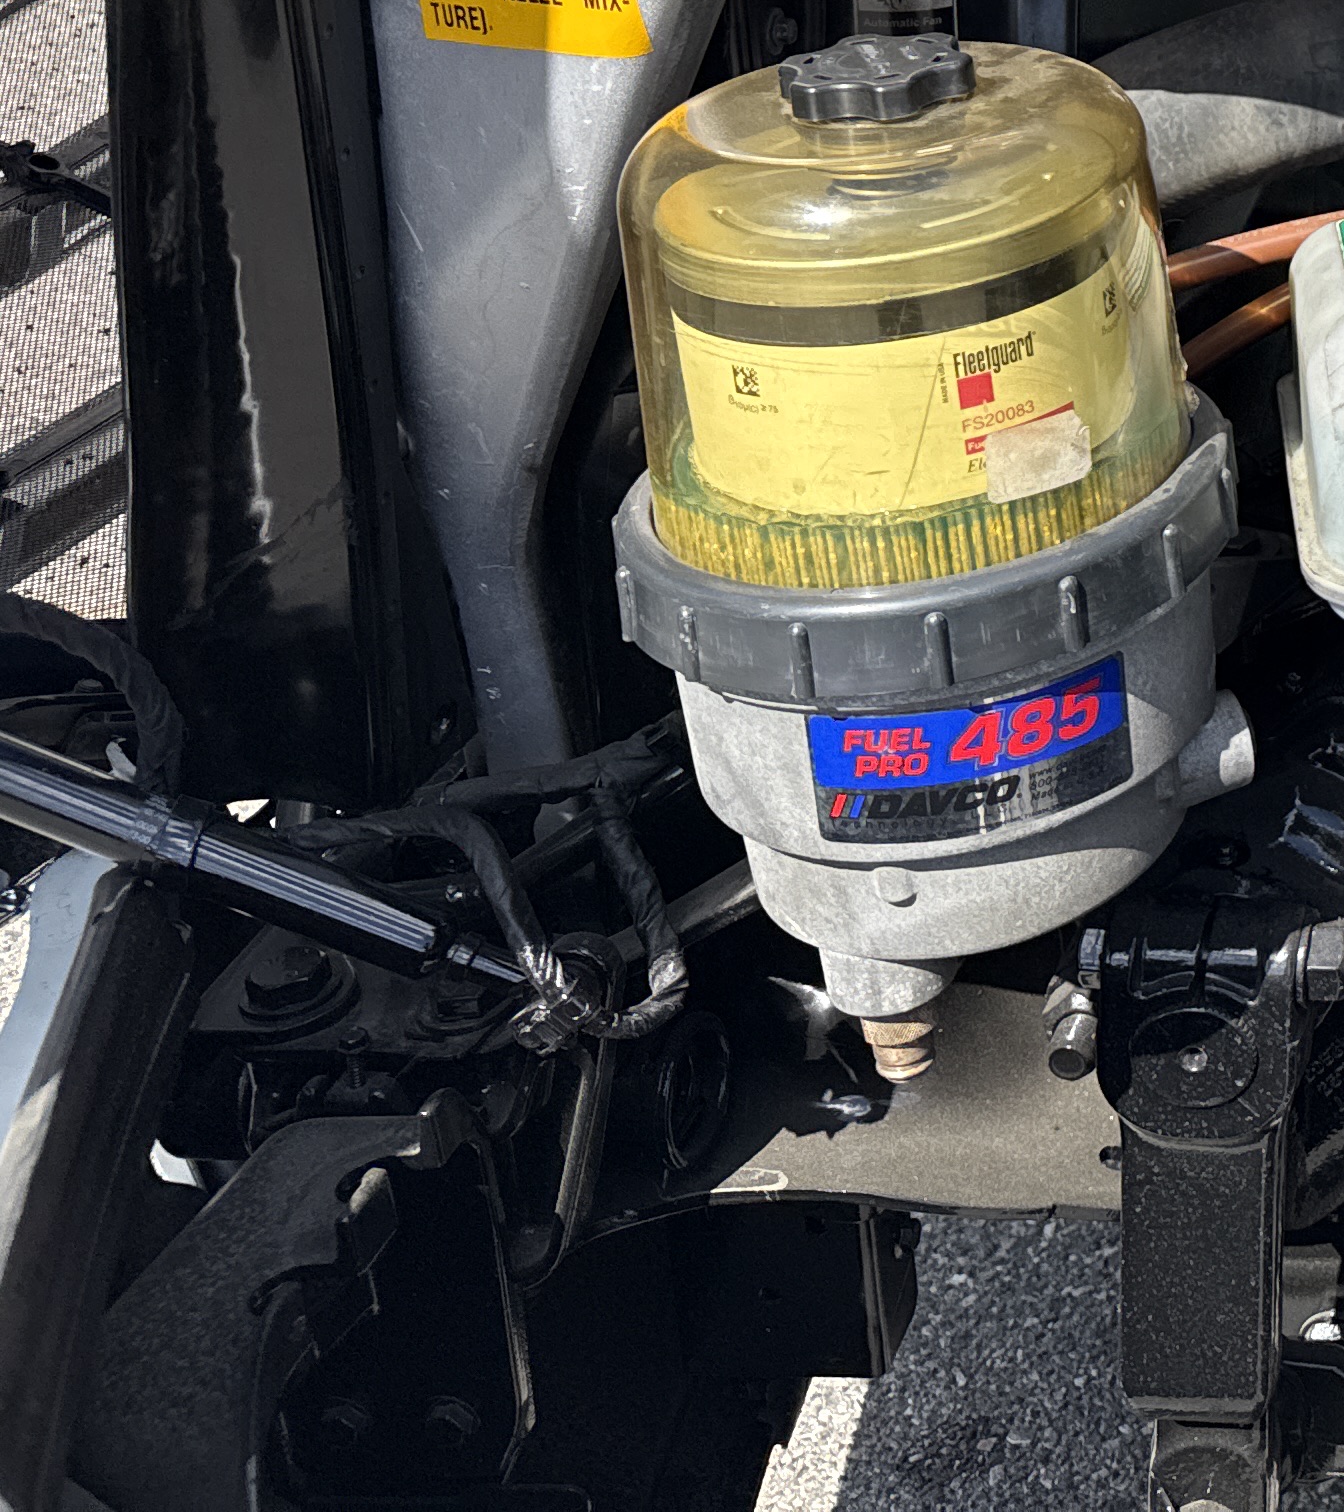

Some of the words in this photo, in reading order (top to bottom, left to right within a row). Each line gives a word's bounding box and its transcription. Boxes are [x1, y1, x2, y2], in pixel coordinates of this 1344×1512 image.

[863, 16, 920, 28] Automatic
[921, 15, 943, 27] Fan
[952, 331, 1036, 379] Fleetguard
[961, 399, 1036, 434] FS20083
[948, 676, 1101, 767] 485
[842, 727, 932, 753] FUEL
[854, 752, 930, 779] PRO
[865, 774, 1022, 820] DAVCO
